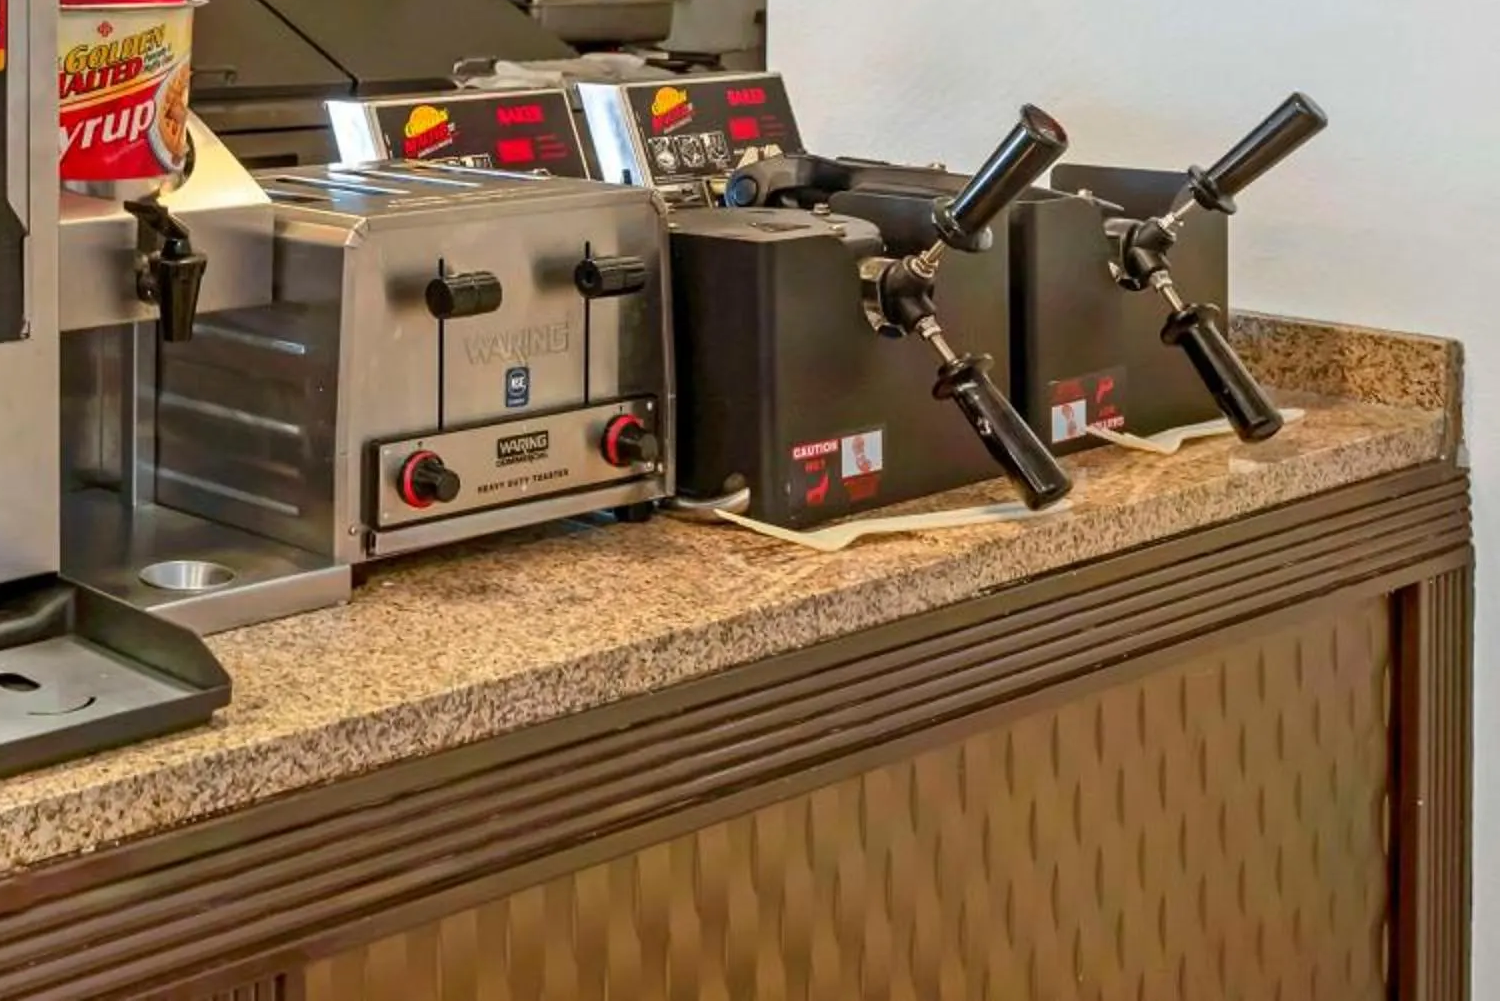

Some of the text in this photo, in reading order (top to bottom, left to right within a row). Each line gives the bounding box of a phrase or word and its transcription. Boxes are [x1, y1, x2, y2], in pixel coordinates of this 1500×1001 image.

[64, 23, 165, 75] GOLDEN
[59, 100, 155, 163] yrup
[463, 322, 568, 366] WARING
[500, 434, 547, 456] WARING
[793, 439, 839, 460] CAUTION
[478, 467, 569, 494] HEAVY DUTY TOASTER
